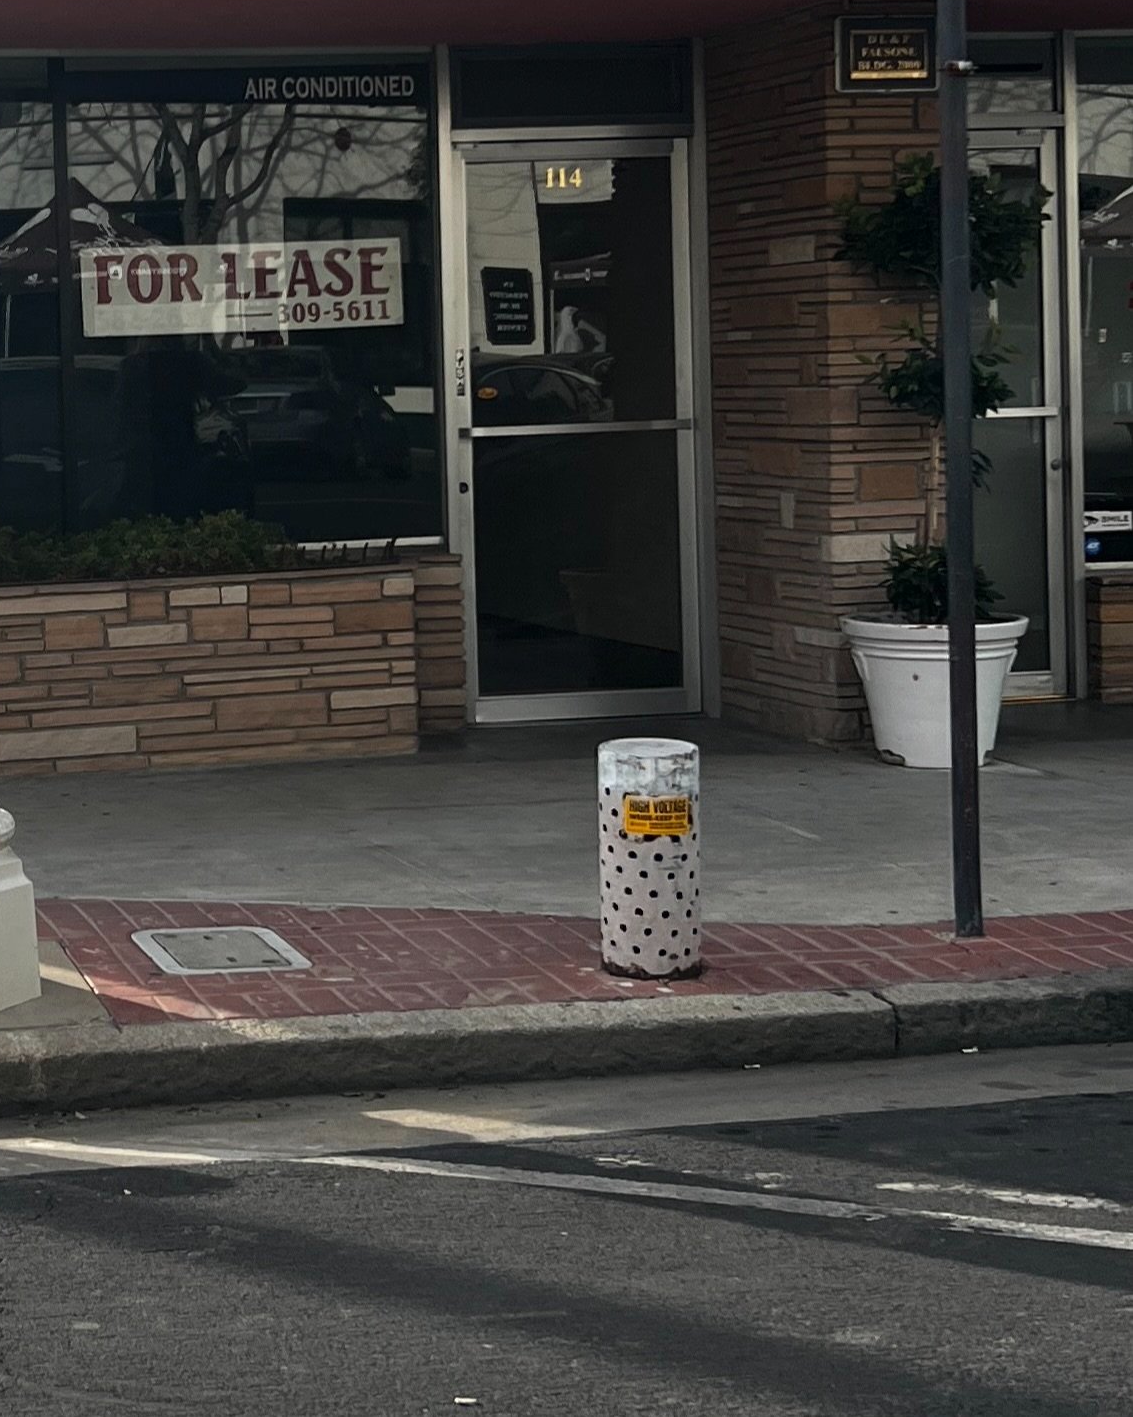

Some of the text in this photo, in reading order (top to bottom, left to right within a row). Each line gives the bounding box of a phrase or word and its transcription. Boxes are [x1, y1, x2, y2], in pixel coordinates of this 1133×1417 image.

[244, 75, 415, 100] AIR CONDITIONED
[545, 167, 583, 188] 114
[94, 246, 392, 305] FOR LEASE
[629, 799, 686, 814] HIGH VOLTAGE
